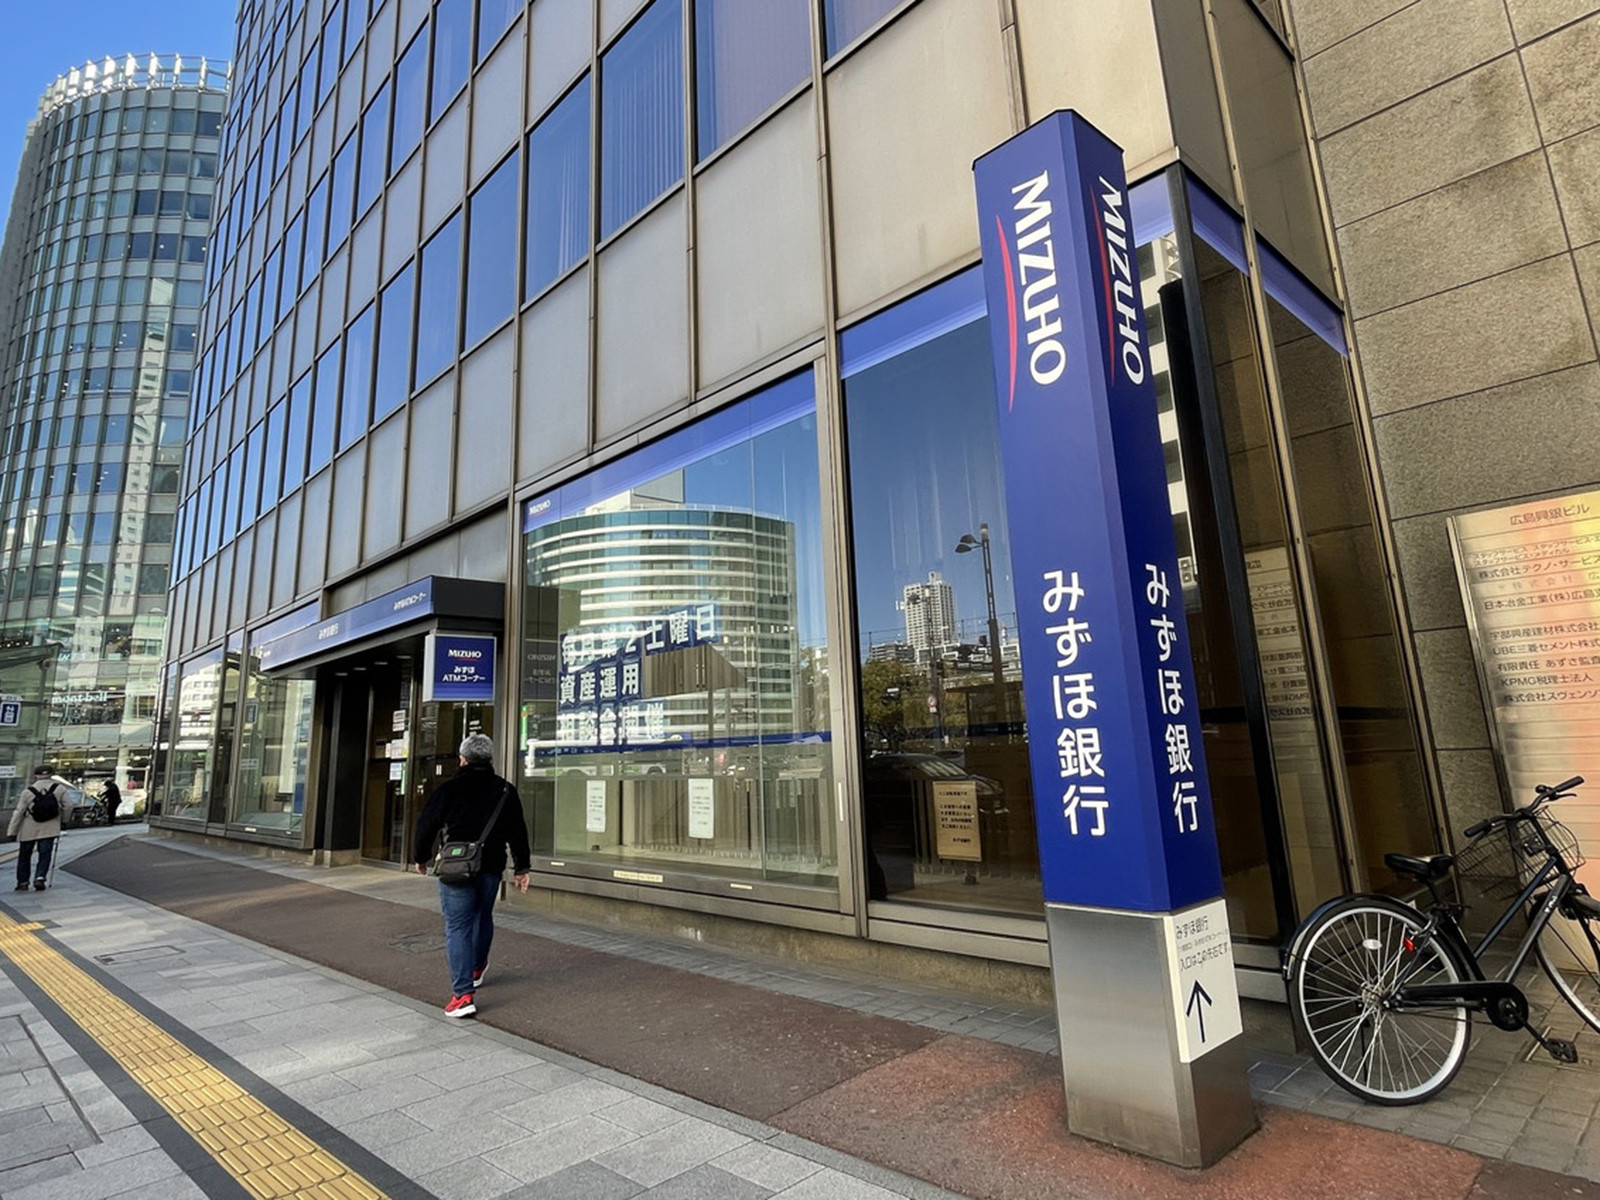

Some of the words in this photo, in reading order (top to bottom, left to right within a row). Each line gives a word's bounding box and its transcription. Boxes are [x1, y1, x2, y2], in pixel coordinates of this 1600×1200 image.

[1011, 169, 1067, 385] MIZUHO
[1099, 175, 1145, 385] MIZUHO
[1510, 504, 1590, 526] 広島興銀ビル
[448, 649, 482, 659] MIZUHO
[442, 673, 486, 682] ATMコーナー
[453, 666, 475, 674] みずほ
[1500, 673, 1593, 688] KPMG税理士法人
[560, 662, 640, 703] 資産運用
[1042, 569, 1109, 836] みずほ銀行
[1145, 563, 1198, 834] みずほ銀行
[1504, 690, 1600, 703] 株式会社スヴェンソ
